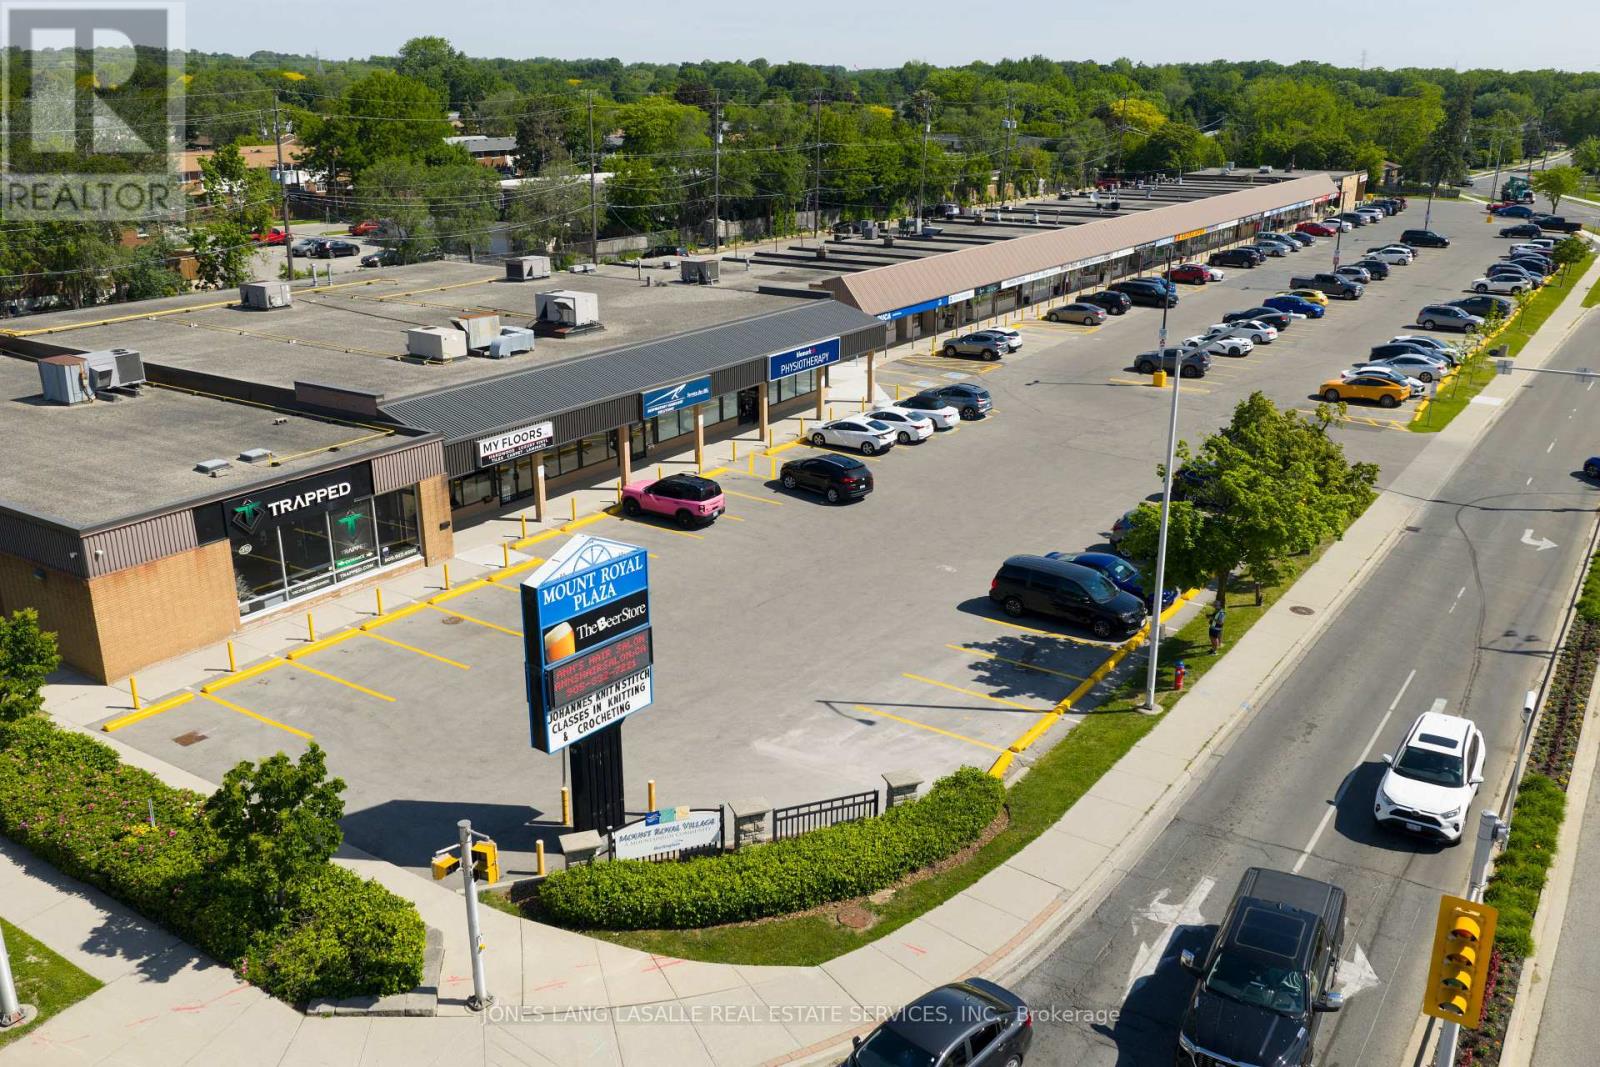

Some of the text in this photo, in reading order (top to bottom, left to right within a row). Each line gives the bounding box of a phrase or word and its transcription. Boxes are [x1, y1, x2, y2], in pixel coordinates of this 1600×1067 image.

[780, 352, 830, 375] PHYSIOTHERAPY
[483, 427, 543, 454] MY FLOORS
[267, 482, 352, 517] TRAPPED
[542, 556, 644, 606] MOUNT ROYAL
[573, 582, 617, 611] PLAZA
[589, 648, 611, 664] HAIR
[616, 634, 646, 652] SALON
[548, 697, 593, 724] JOHANNES
[552, 682, 646, 734] CLASSES IN KNITTING
[563, 701, 631, 742] & CROCHETING
[682, 818, 715, 829] VILLAGE
